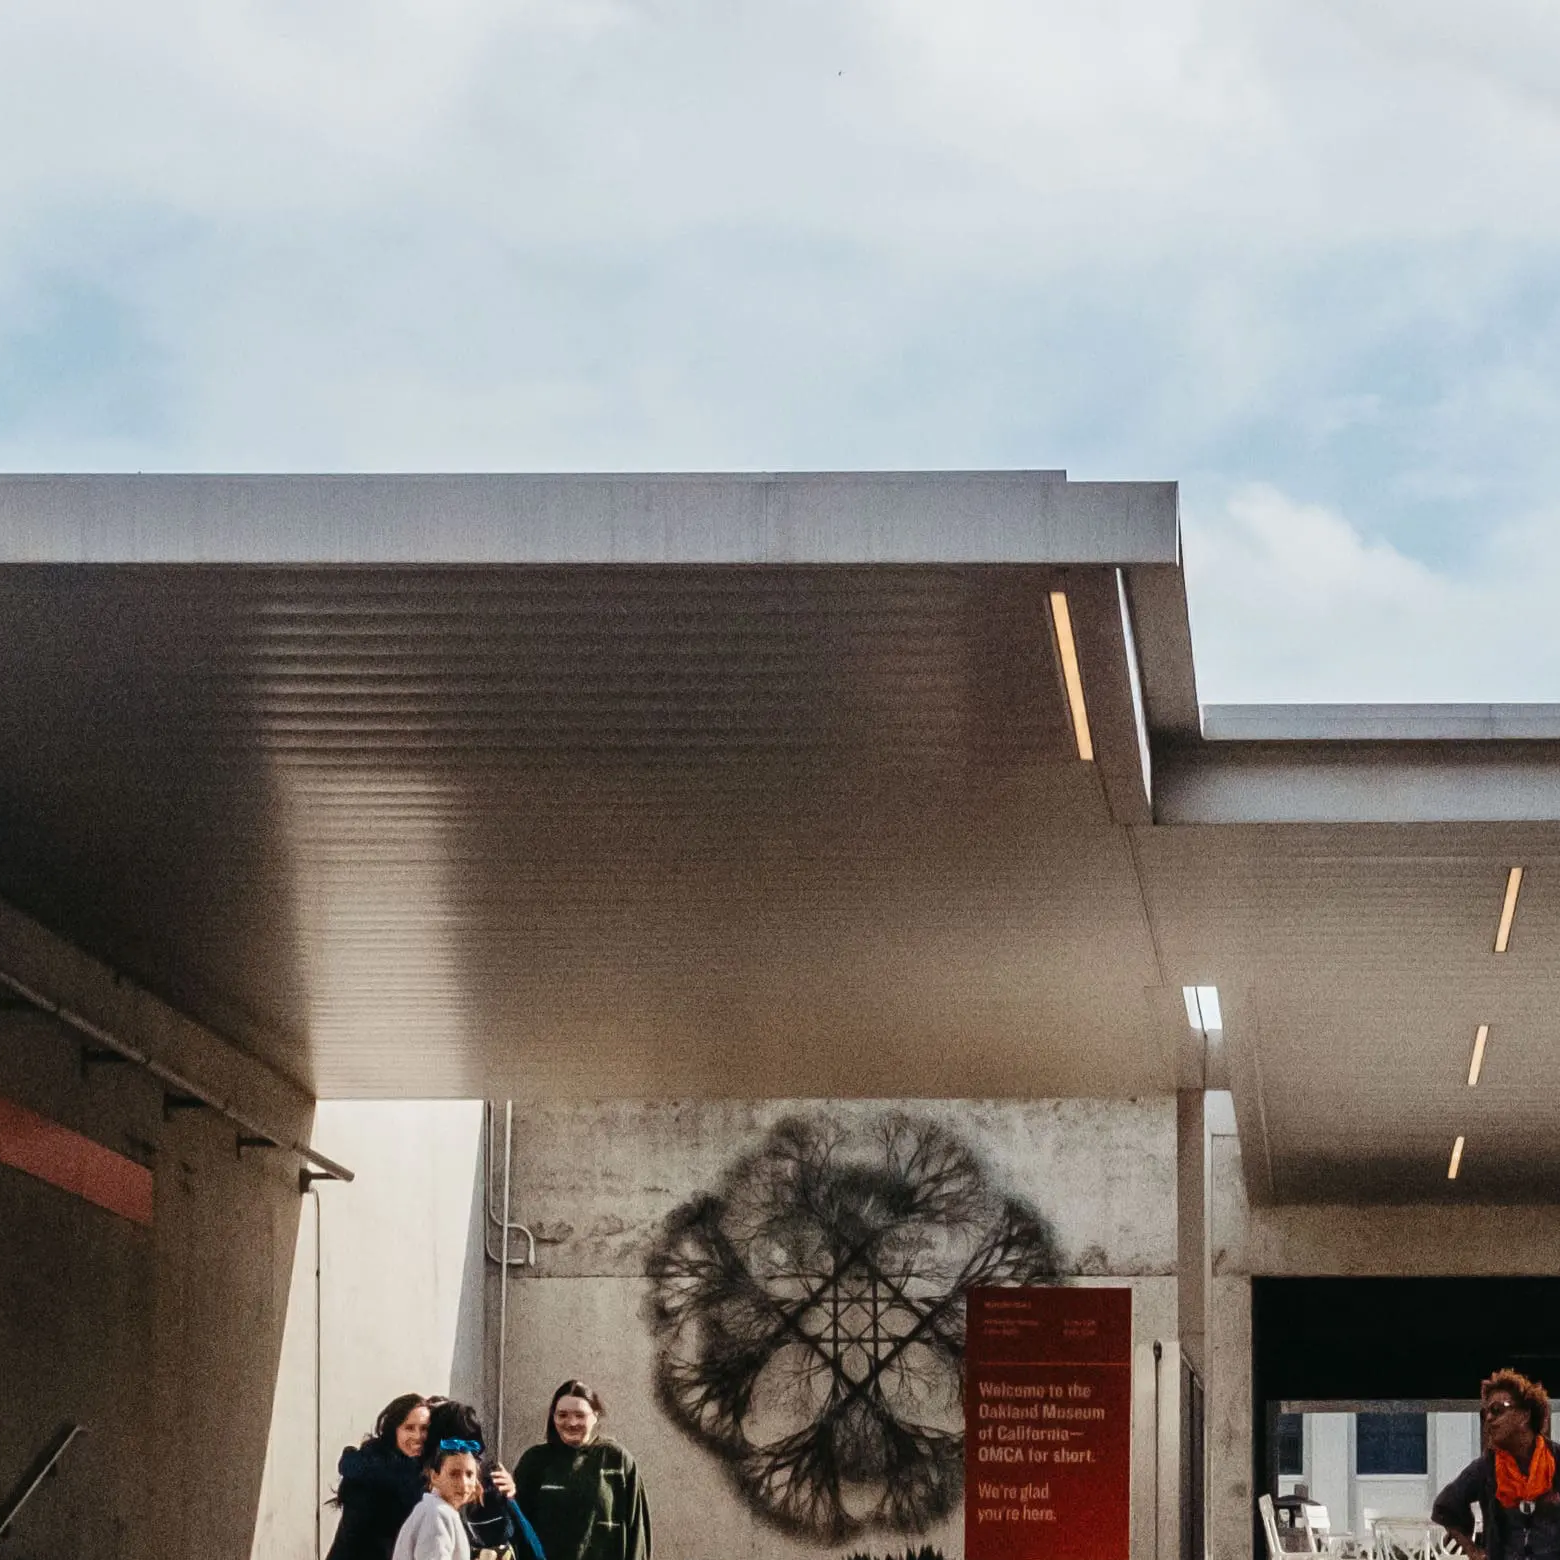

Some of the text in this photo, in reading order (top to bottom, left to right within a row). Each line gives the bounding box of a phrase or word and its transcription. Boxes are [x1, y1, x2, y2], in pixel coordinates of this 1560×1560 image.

[979, 1381, 1092, 1398] Welcome to the
[979, 1403, 1105, 1420] Oakland Museum
[978, 1425, 993, 1441] of
[978, 1446, 1096, 1463] OMCA for short.
[1019, 1482, 1049, 1502] glad
[1023, 1504, 1057, 1521] here.
